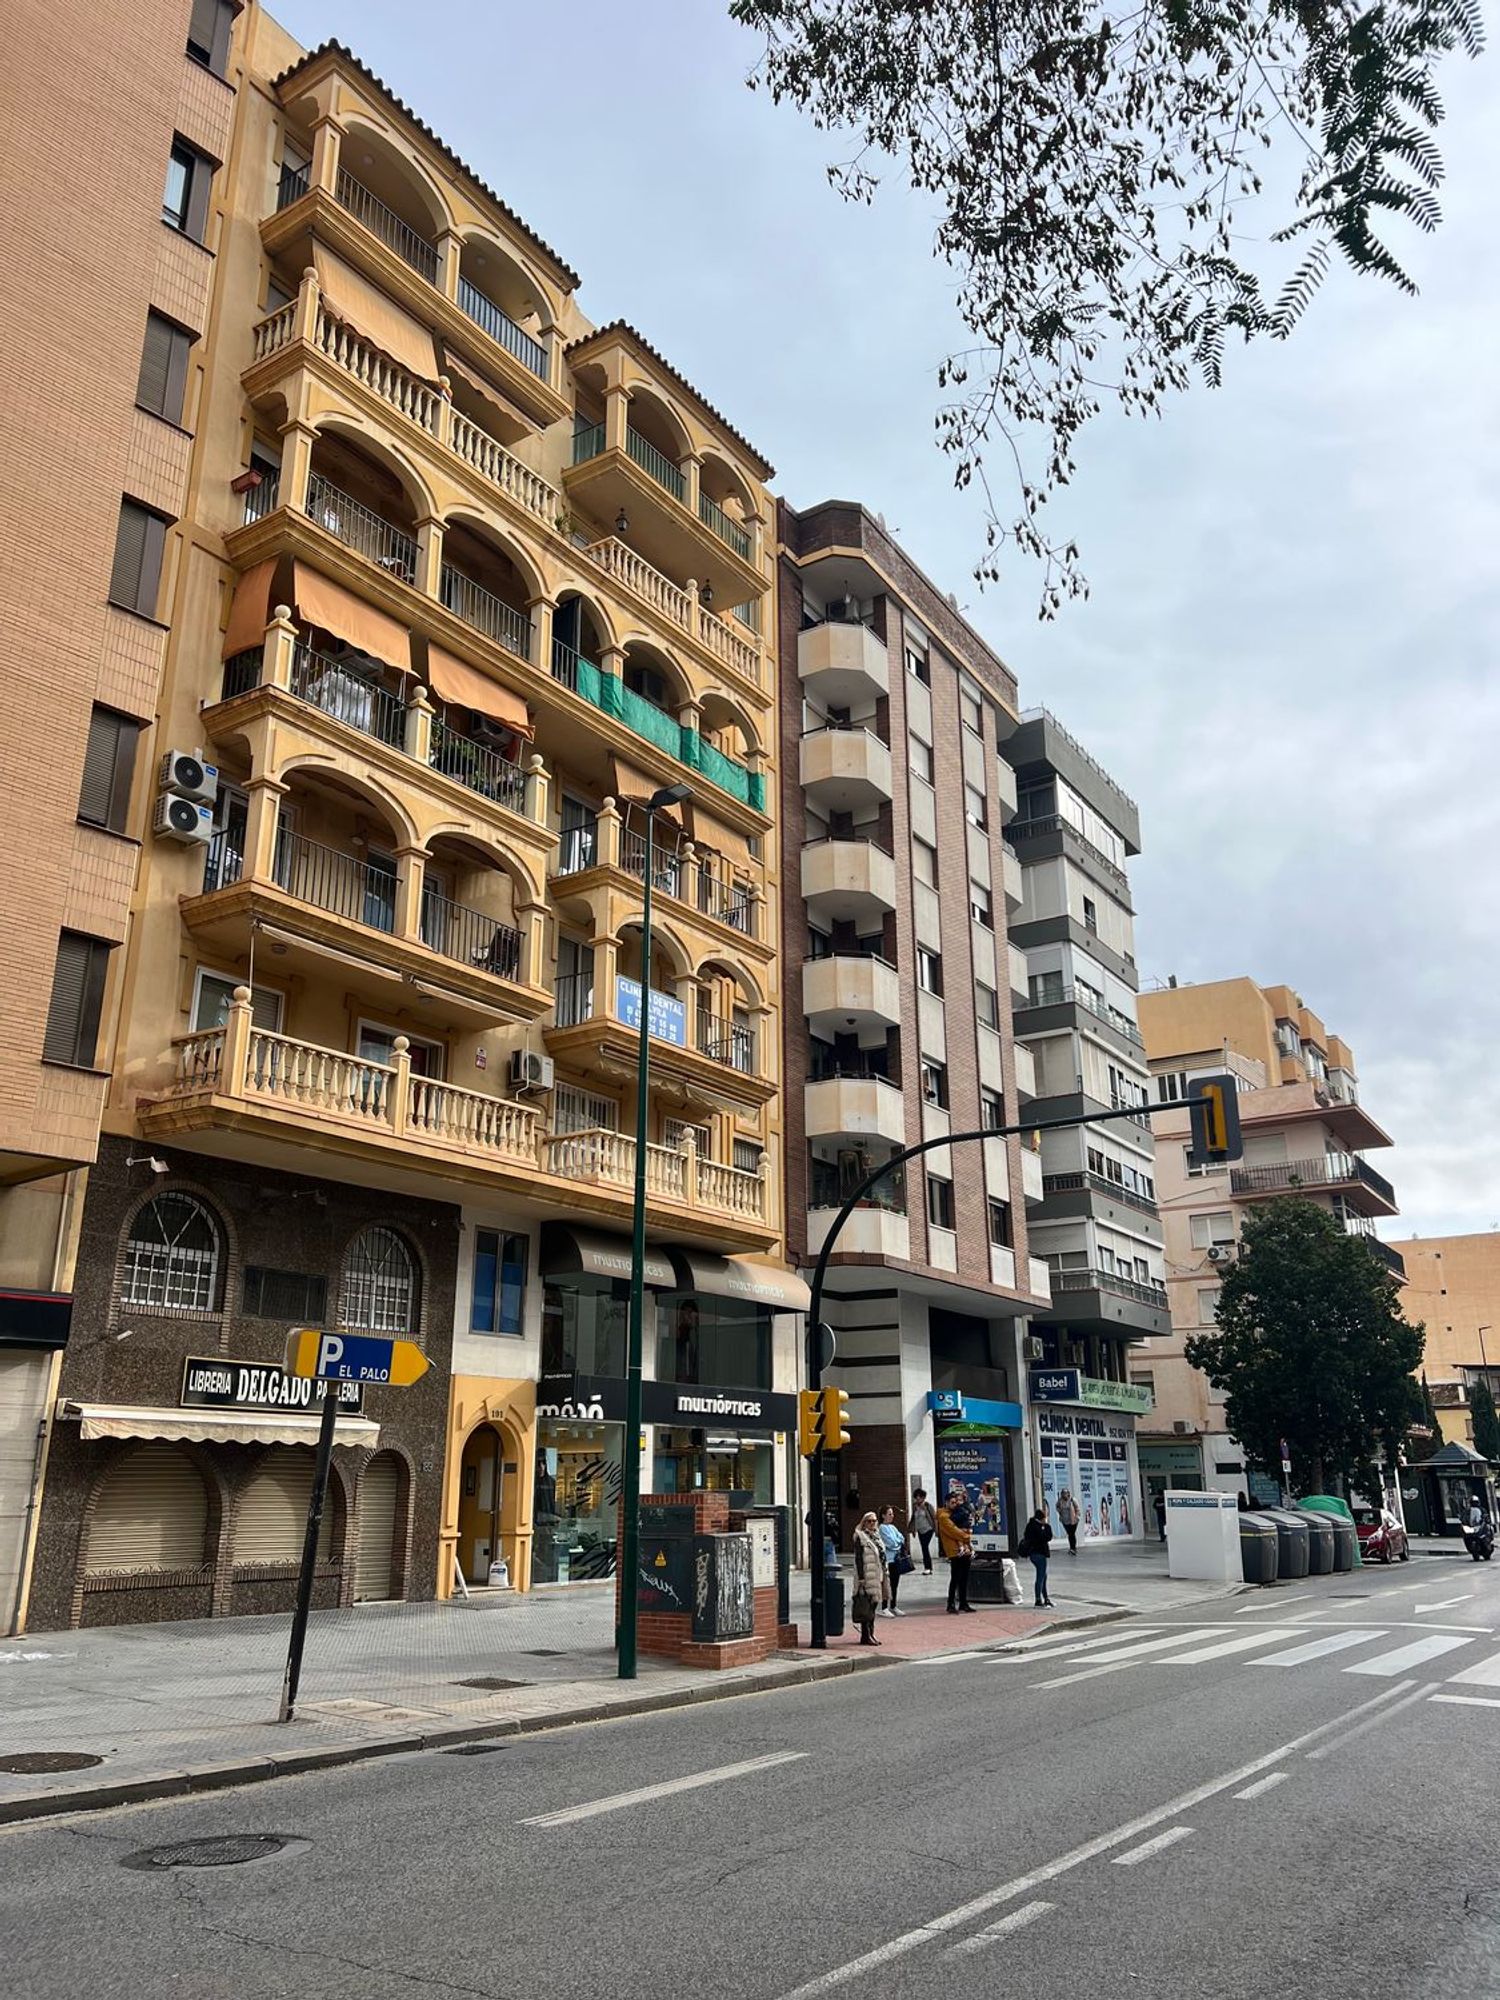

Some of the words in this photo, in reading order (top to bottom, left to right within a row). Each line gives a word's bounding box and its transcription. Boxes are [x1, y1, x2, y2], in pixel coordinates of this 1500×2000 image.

[653, 994, 683, 1016] DENTAL
[318, 1335, 344, 1375] P
[339, 1365, 352, 1378] EL
[360, 1367, 388, 1381] PALO
[1039, 1376, 1068, 1388] Babel
[189, 1369, 231, 1395] LIBRERIA
[236, 1369, 311, 1406] DELGADO
[316, 1380, 359, 1402] PALERIA
[1039, 1409, 1075, 1435] CLÍNICA
[1075, 1417, 1107, 1437] DENTAL
